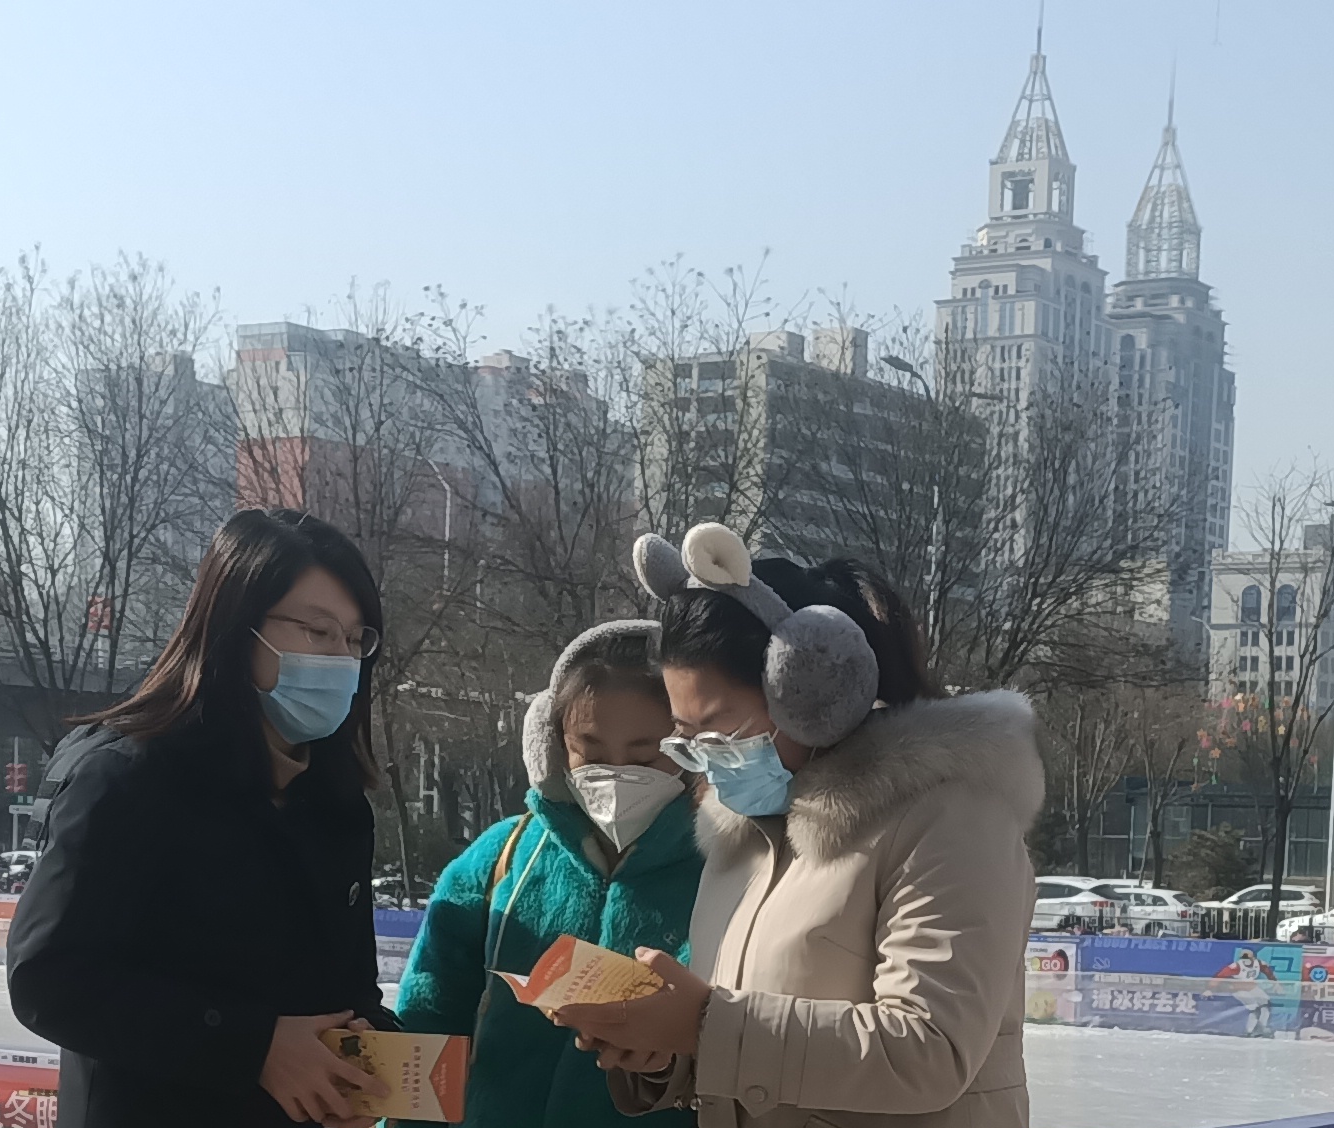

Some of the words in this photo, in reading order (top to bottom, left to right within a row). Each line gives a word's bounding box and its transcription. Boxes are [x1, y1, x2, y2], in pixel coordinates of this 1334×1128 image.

[1041, 959, 1061, 971] GO
[1092, 988, 1198, 1014] 滑冰好去处
